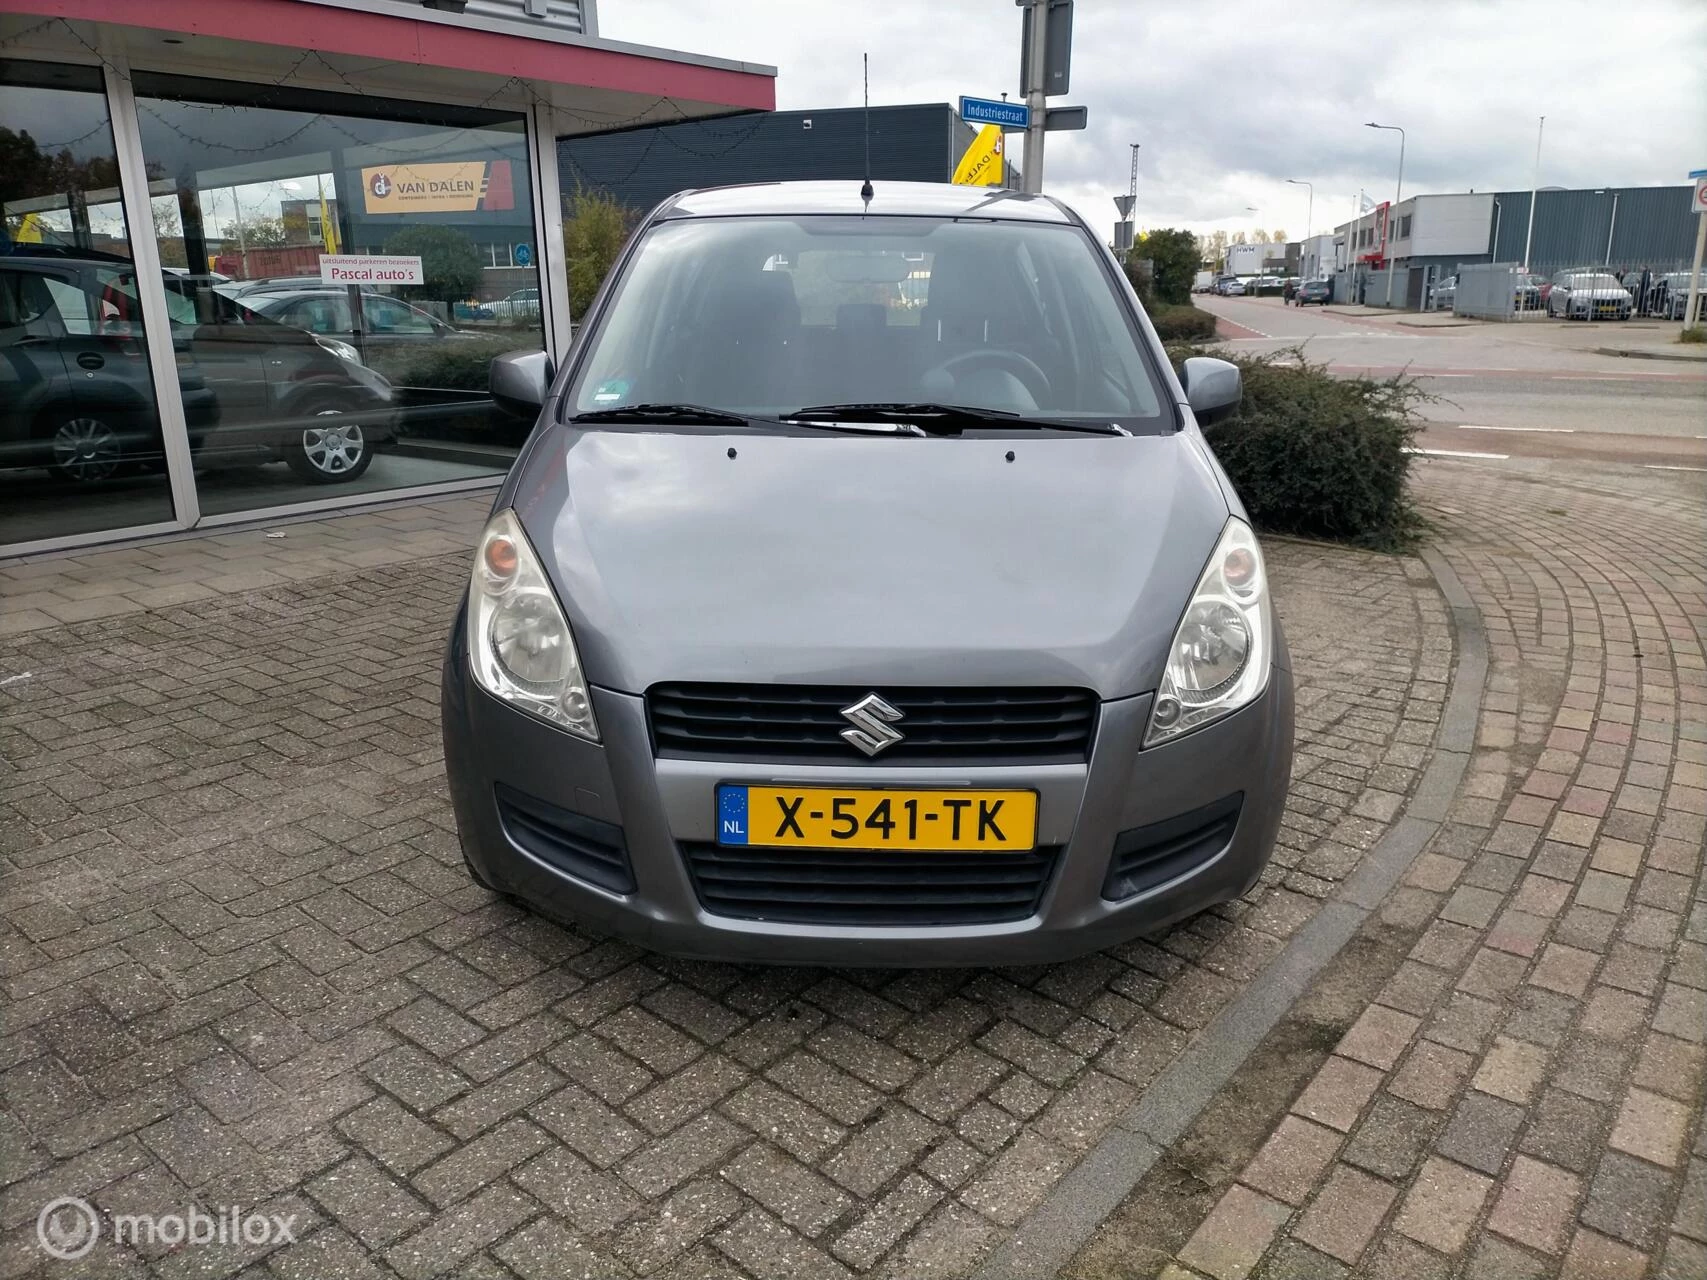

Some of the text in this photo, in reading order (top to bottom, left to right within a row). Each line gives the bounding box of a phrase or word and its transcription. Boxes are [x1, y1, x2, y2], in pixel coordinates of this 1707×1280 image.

[967, 103, 1023, 121] Industriestraat
[397, 181, 474, 193] VAN DALEN
[1236, 246, 1255, 254] HWM
[331, 268, 414, 279] Pascal auto's
[775, 797, 1007, 841] X-541-TK
[724, 820, 744, 834] NL
